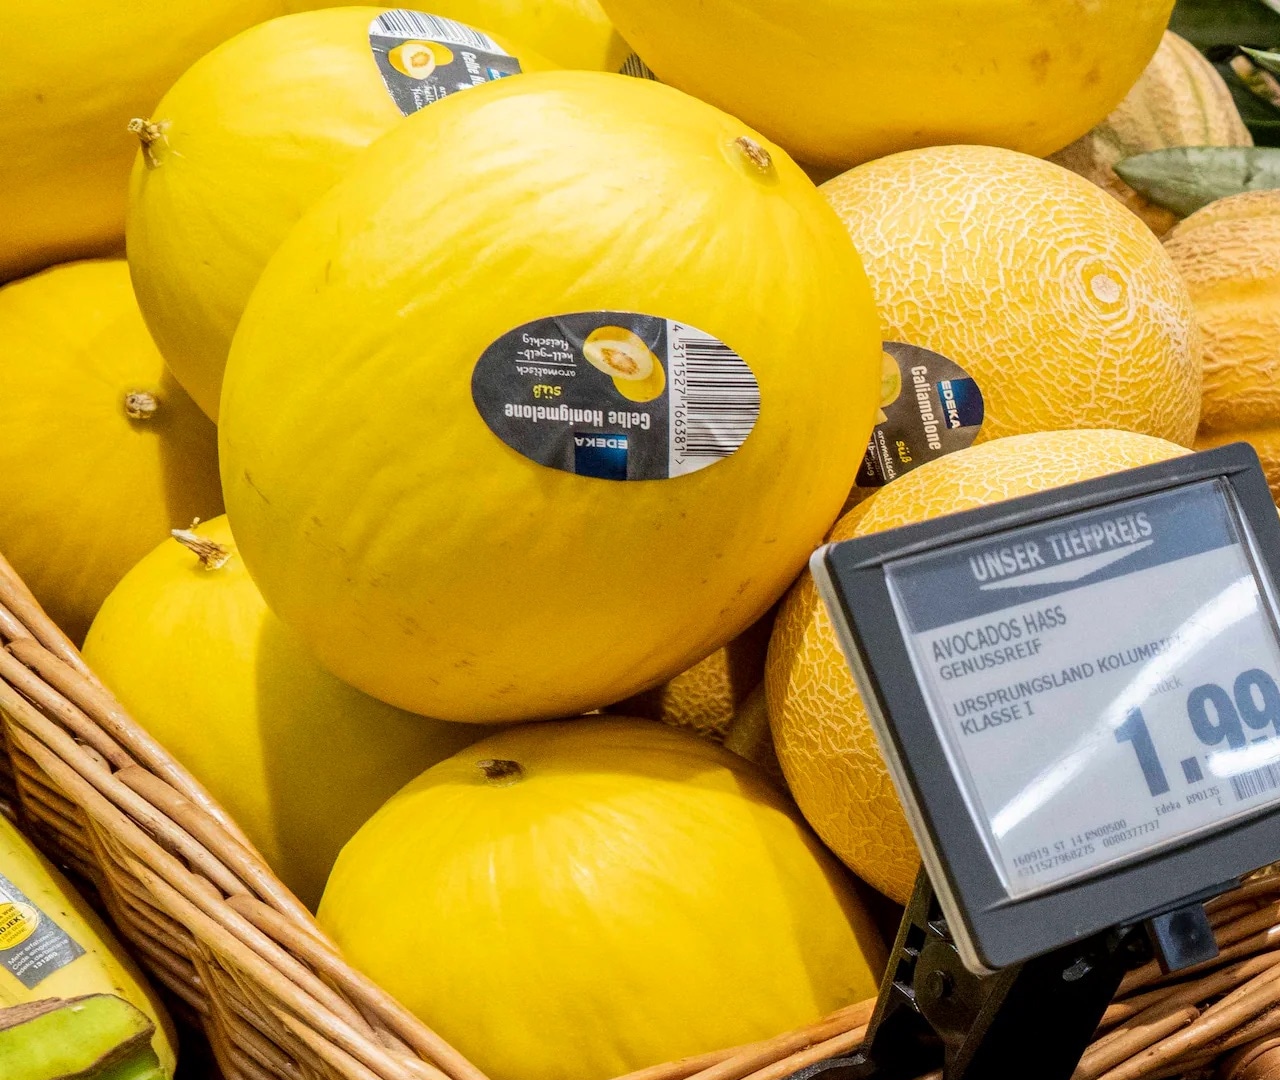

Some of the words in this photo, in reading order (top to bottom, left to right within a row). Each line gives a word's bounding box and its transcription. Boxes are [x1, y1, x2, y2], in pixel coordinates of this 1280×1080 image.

[516, 347, 575, 362] hell-gelb-
[521, 333, 571, 351] fleischig
[515, 365, 577, 378] aromatisch
[532, 383, 562, 400] süß
[940, 380, 961, 429] EDEKA
[504, 403, 604, 428] Honigmelone
[608, 410, 650, 430] Gelbe
[910, 365, 942, 450] Galiamelone
[574, 436, 628, 450] EDEKA
[877, 429, 898, 480] aromatisch
[895, 440, 913, 464] süß
[969, 540, 1045, 582] UNSER
[1050, 511, 1153, 560] TIEFPREIS
[931, 613, 1023, 662] AVOCADOS
[1026, 605, 1068, 636] HASS
[939, 638, 1044, 681] GENUSSREIF
[952, 662, 1095, 718] URSPRUNGSLAND
[1098, 634, 1190, 674] KOLUMBI
[961, 705, 1024, 736] KLASSE
[1025, 701, 1035, 717] I
[1155, 801, 1182, 816] Edeka
[1012, 848, 1050, 869] 160919
[1054, 841, 1068, 852] ST
[1070, 835, 1084, 848] 14
